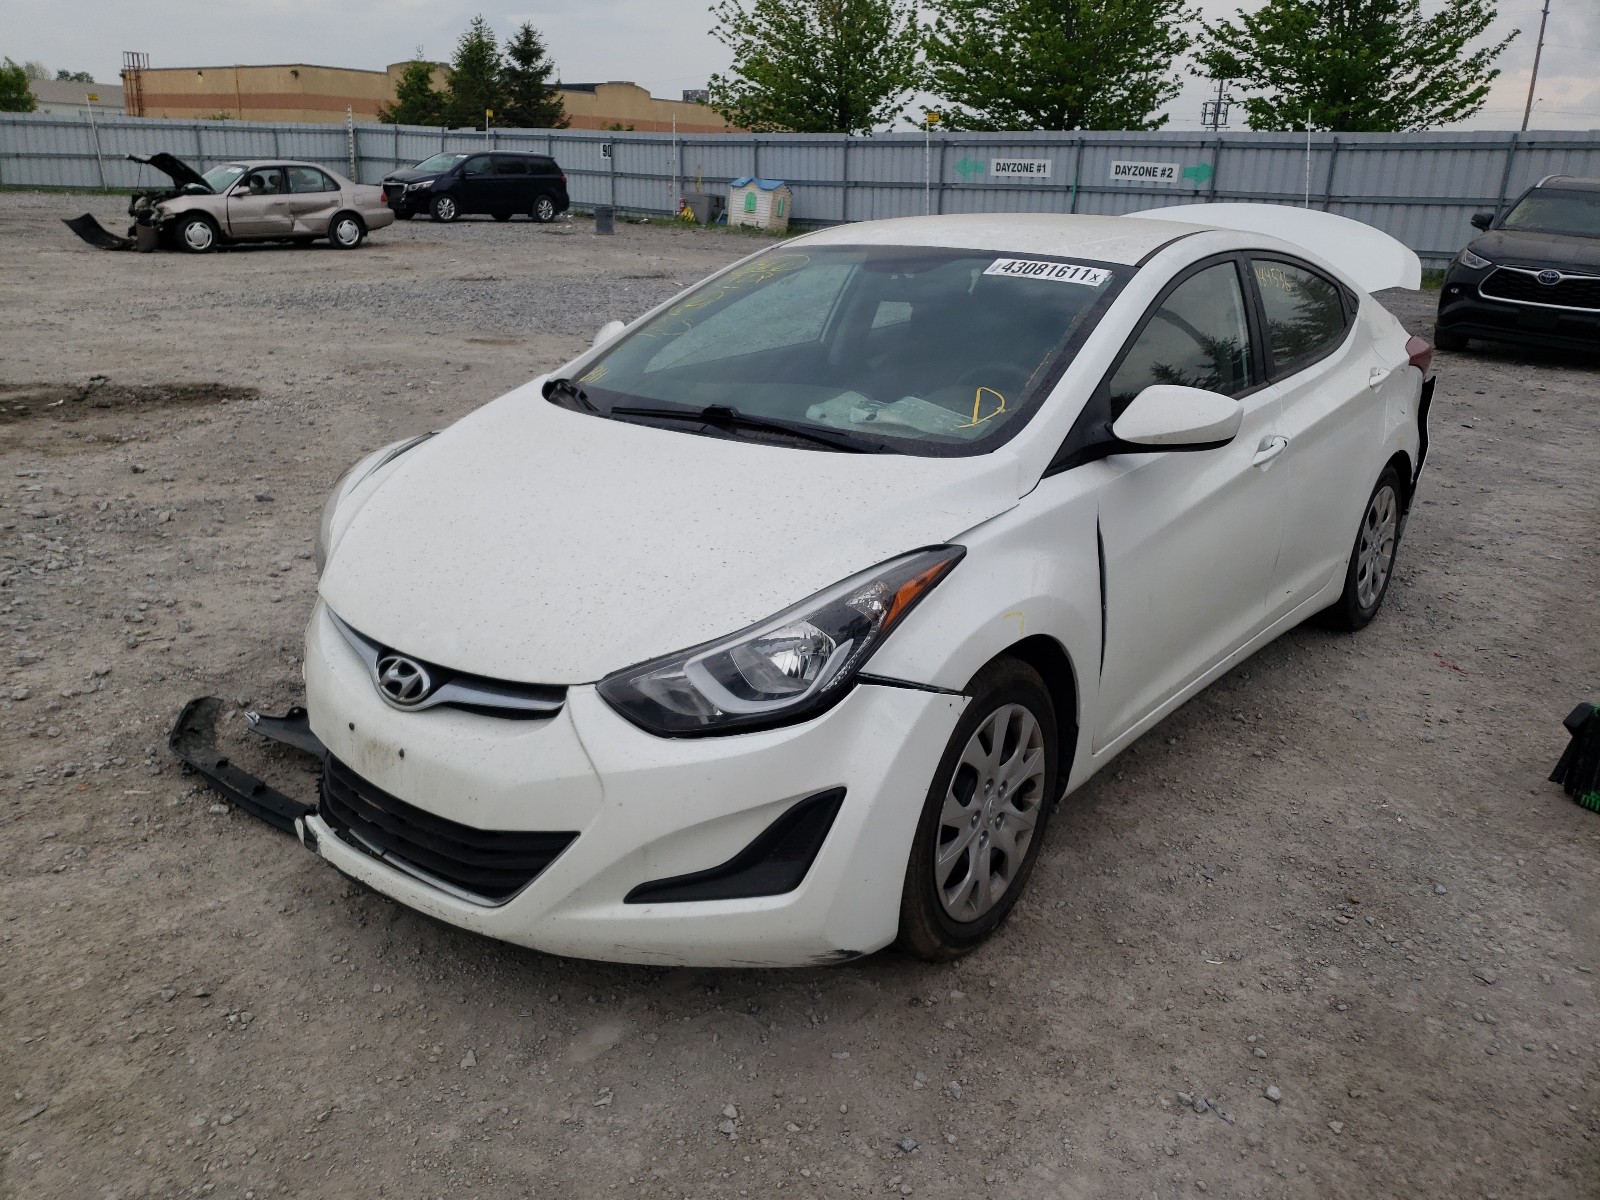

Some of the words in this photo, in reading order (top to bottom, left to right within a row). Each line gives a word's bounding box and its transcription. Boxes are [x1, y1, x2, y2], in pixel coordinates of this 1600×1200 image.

[602, 144, 612, 158] 90
[995, 162, 1035, 174] DAYZONE
[1036, 163, 1047, 174] #1
[1114, 164, 1158, 178] DAYZONE
[1160, 167, 1173, 179] #2
